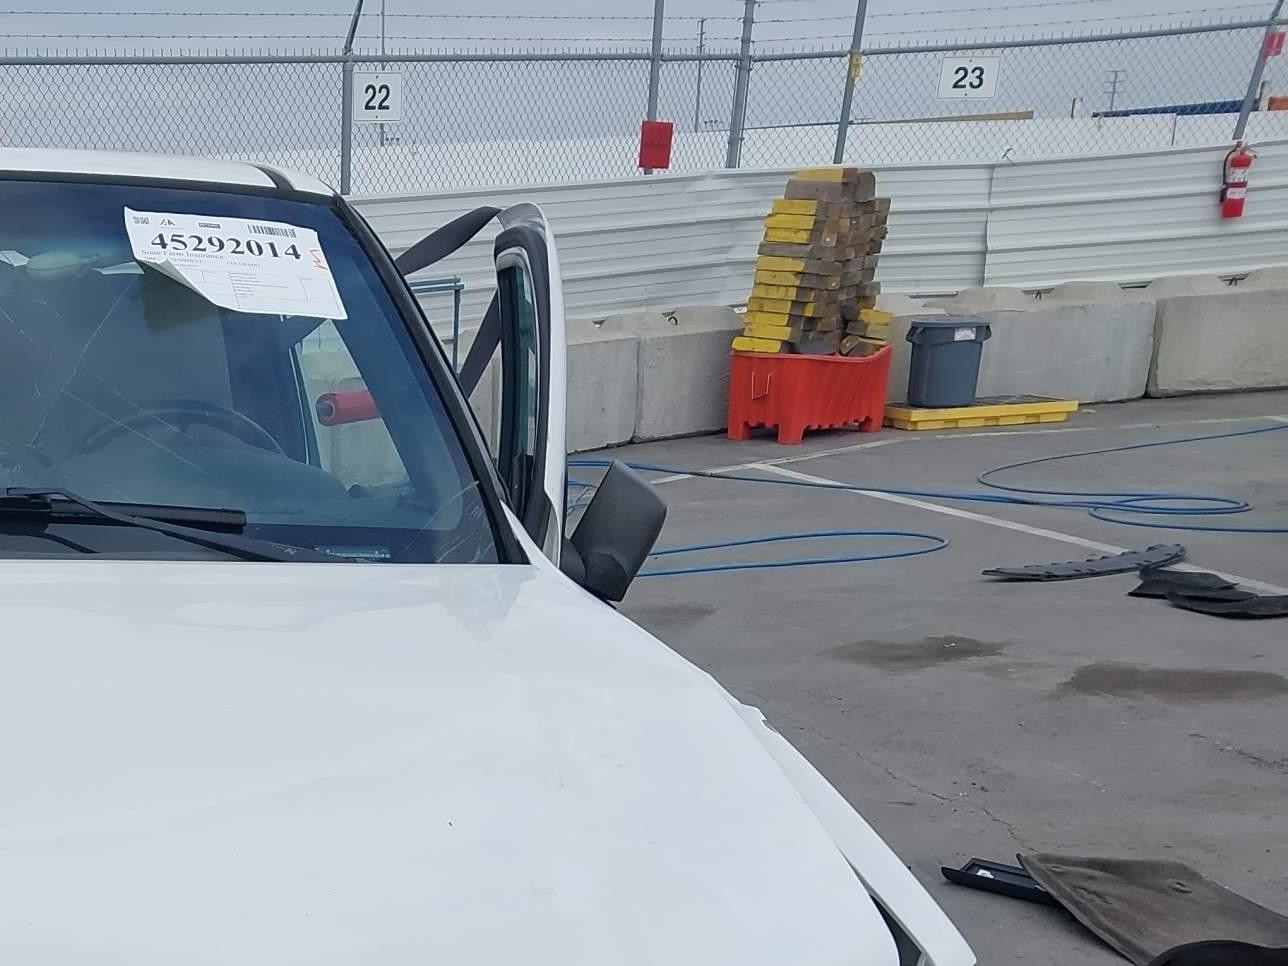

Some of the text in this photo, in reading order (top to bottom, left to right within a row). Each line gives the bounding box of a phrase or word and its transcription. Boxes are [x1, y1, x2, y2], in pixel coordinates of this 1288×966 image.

[952, 66, 984, 89] 23
[365, 84, 390, 110] 22
[150, 232, 302, 260] 45292014
